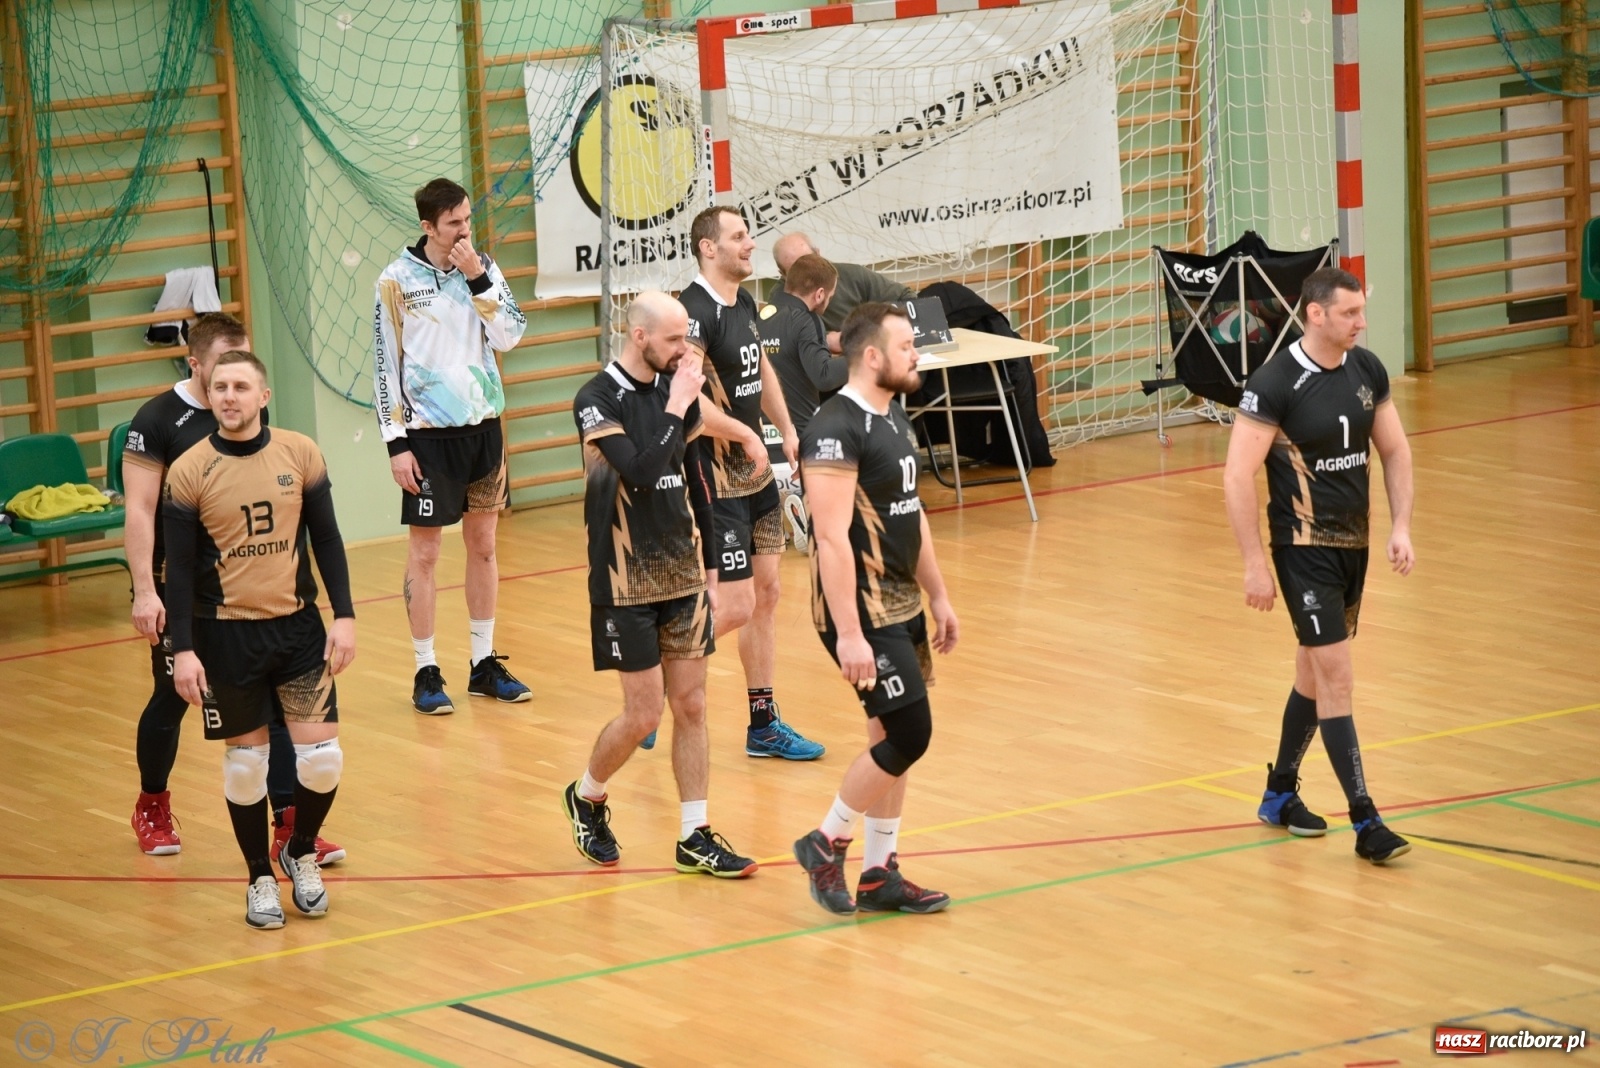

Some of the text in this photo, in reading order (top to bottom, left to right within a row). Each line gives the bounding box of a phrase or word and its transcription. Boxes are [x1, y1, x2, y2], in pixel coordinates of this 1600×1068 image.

[771, 16, 798, 28] sport
[828, 145, 866, 187] W
[407, 301, 432, 311] KIETRZ
[761, 338, 780, 346] MAR
[376, 348, 386, 373] POD
[739, 343, 760, 378] 99
[378, 375, 393, 427] WIRTUOZ
[1338, 415, 1350, 449] 1
[656, 474, 683, 490] OTIM
[899, 455, 917, 493] 10
[418, 498, 434, 517] 19
[240, 500, 275, 538] 13
[227, 539, 289, 559] AGROTIM
[722, 549, 747, 571] 99
[1310, 614, 1321, 635] 1
[611, 641, 623, 661] 4
[880, 674, 905, 700] 10
[204, 708, 223, 729] 13
